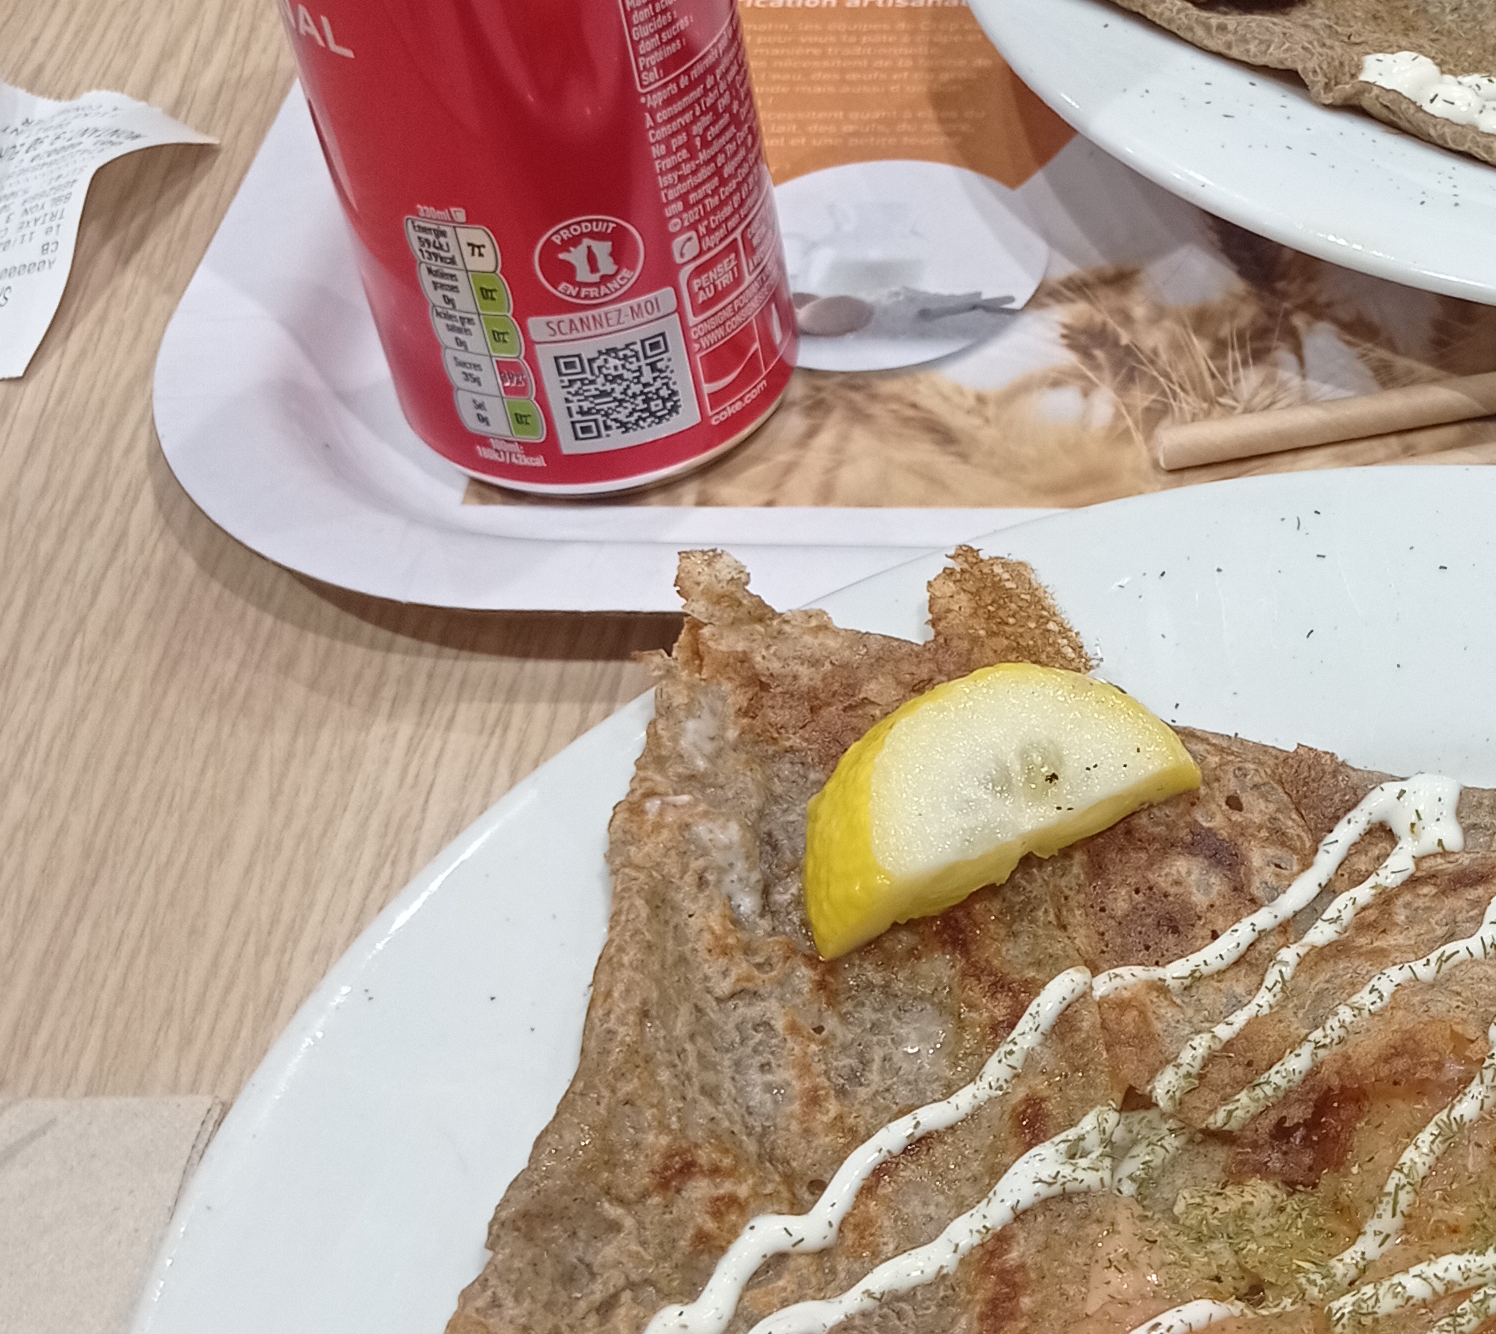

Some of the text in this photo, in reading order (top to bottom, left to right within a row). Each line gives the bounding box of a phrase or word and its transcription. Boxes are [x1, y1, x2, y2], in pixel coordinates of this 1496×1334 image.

[641, 67, 659, 85] Sel
[682, 204, 704, 227] 2021
[41, 240, 59, 255] CB
[550, 221, 617, 245] PRODUIT
[557, 267, 635, 299] EN FRANCE
[693, 253, 738, 293] PENSEZ
[698, 286, 715, 304] AU
[714, 273, 733, 291] TRI
[546, 297, 661, 338] SCANNEZ-MOI
[691, 303, 734, 340] CONSIGNE
[711, 379, 768, 426] coke.com
